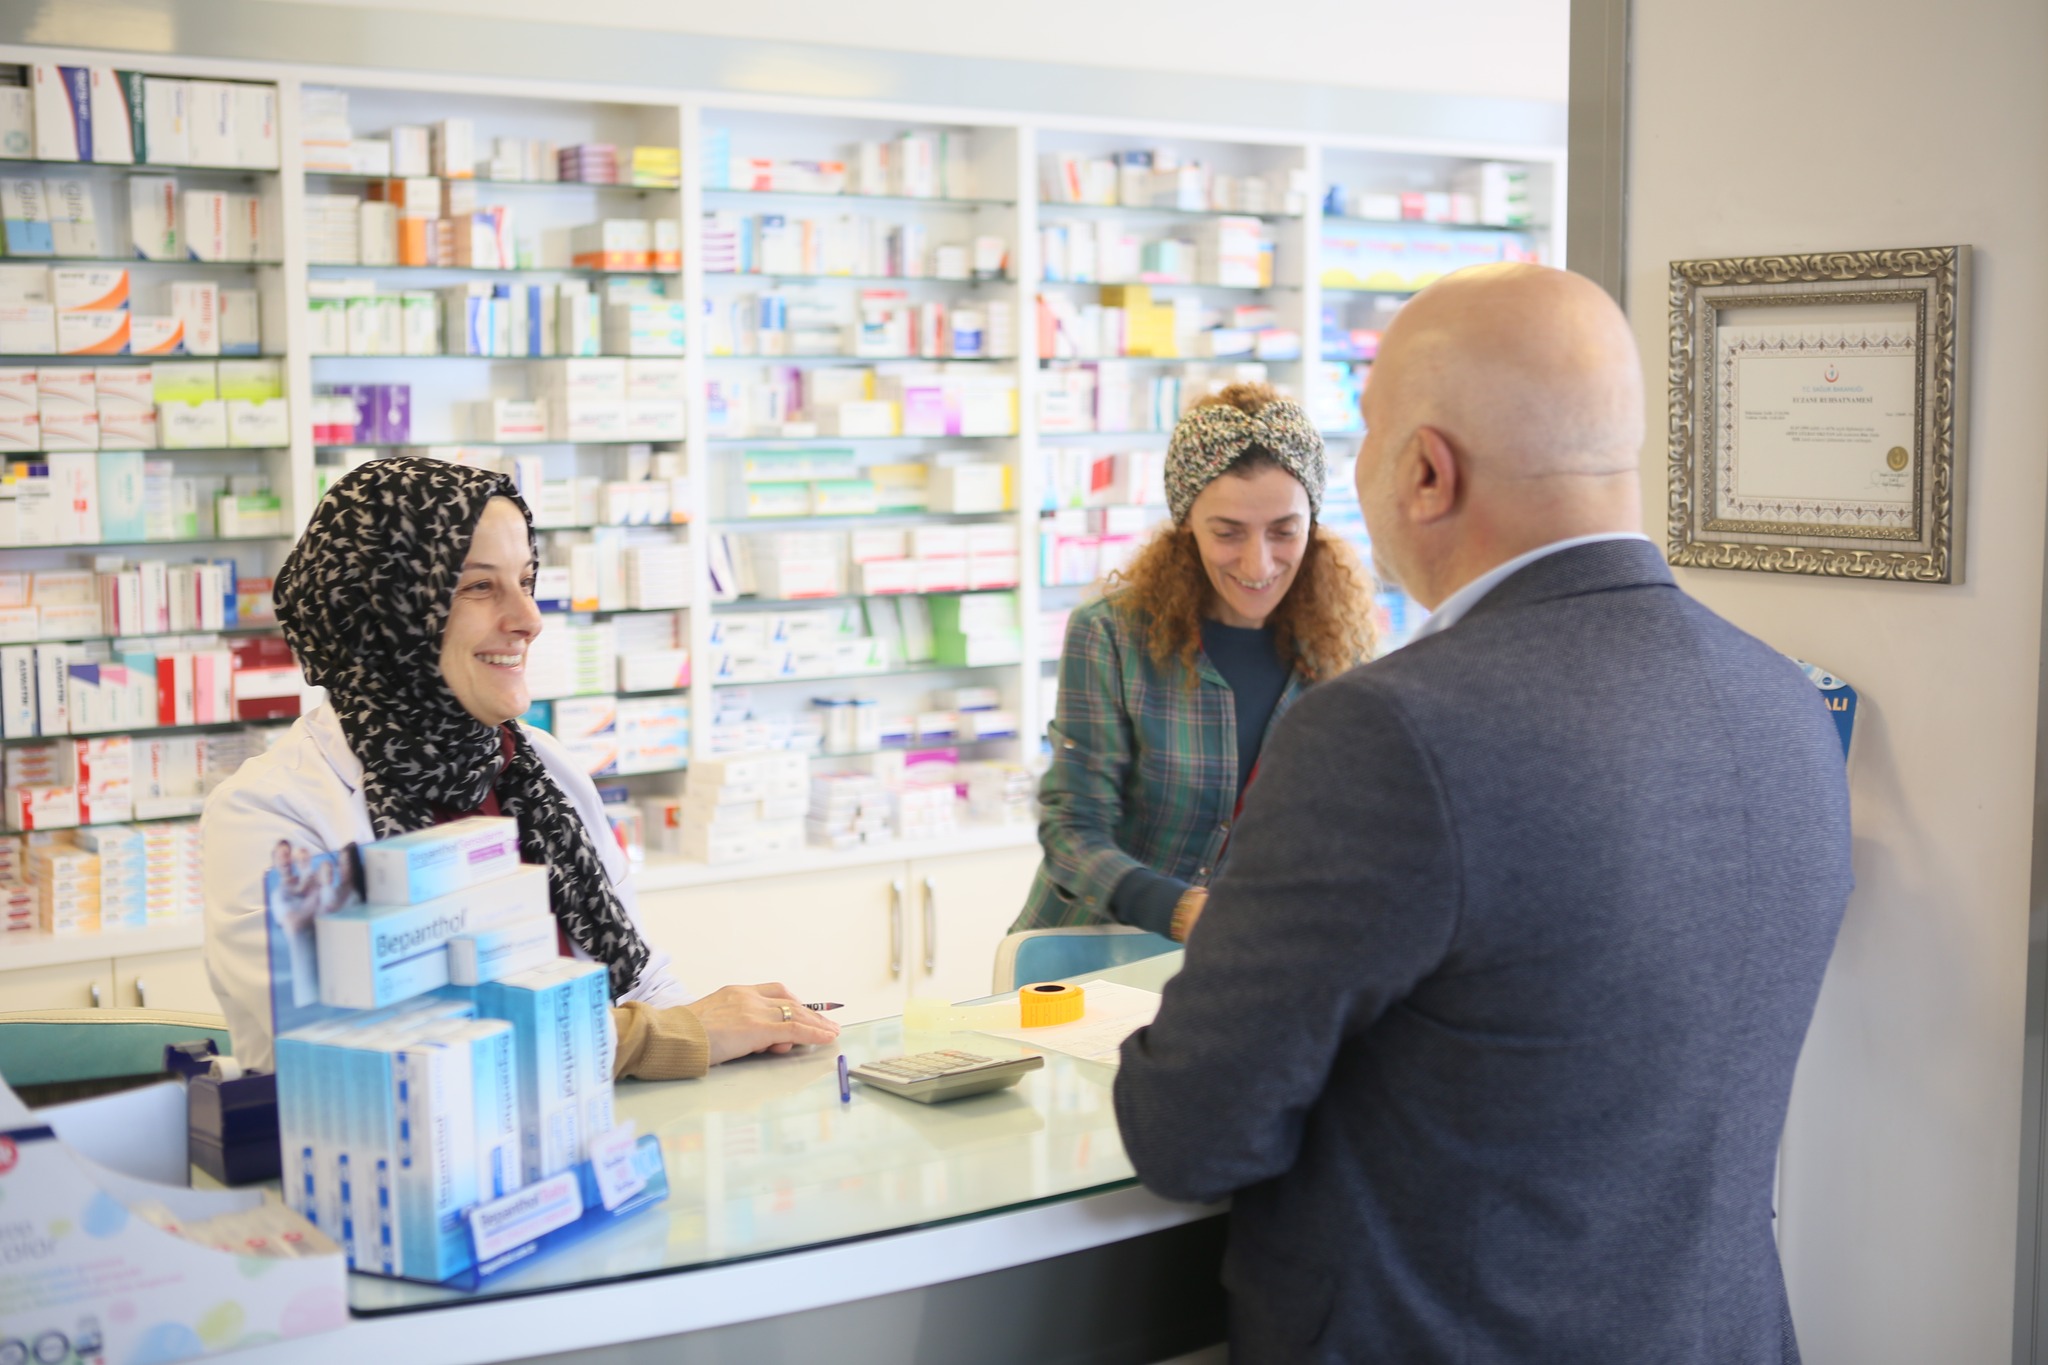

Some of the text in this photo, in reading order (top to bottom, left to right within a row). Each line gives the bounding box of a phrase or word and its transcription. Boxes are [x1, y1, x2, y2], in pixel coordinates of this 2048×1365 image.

[376, 907, 467, 959] Bepanthol
[558, 985, 576, 1098] Bepanthol
[592, 973, 610, 1084] Bepanthol
[498, 1033, 515, 1134] Bepanthol
[480, 1195, 540, 1226] Bepanthol
